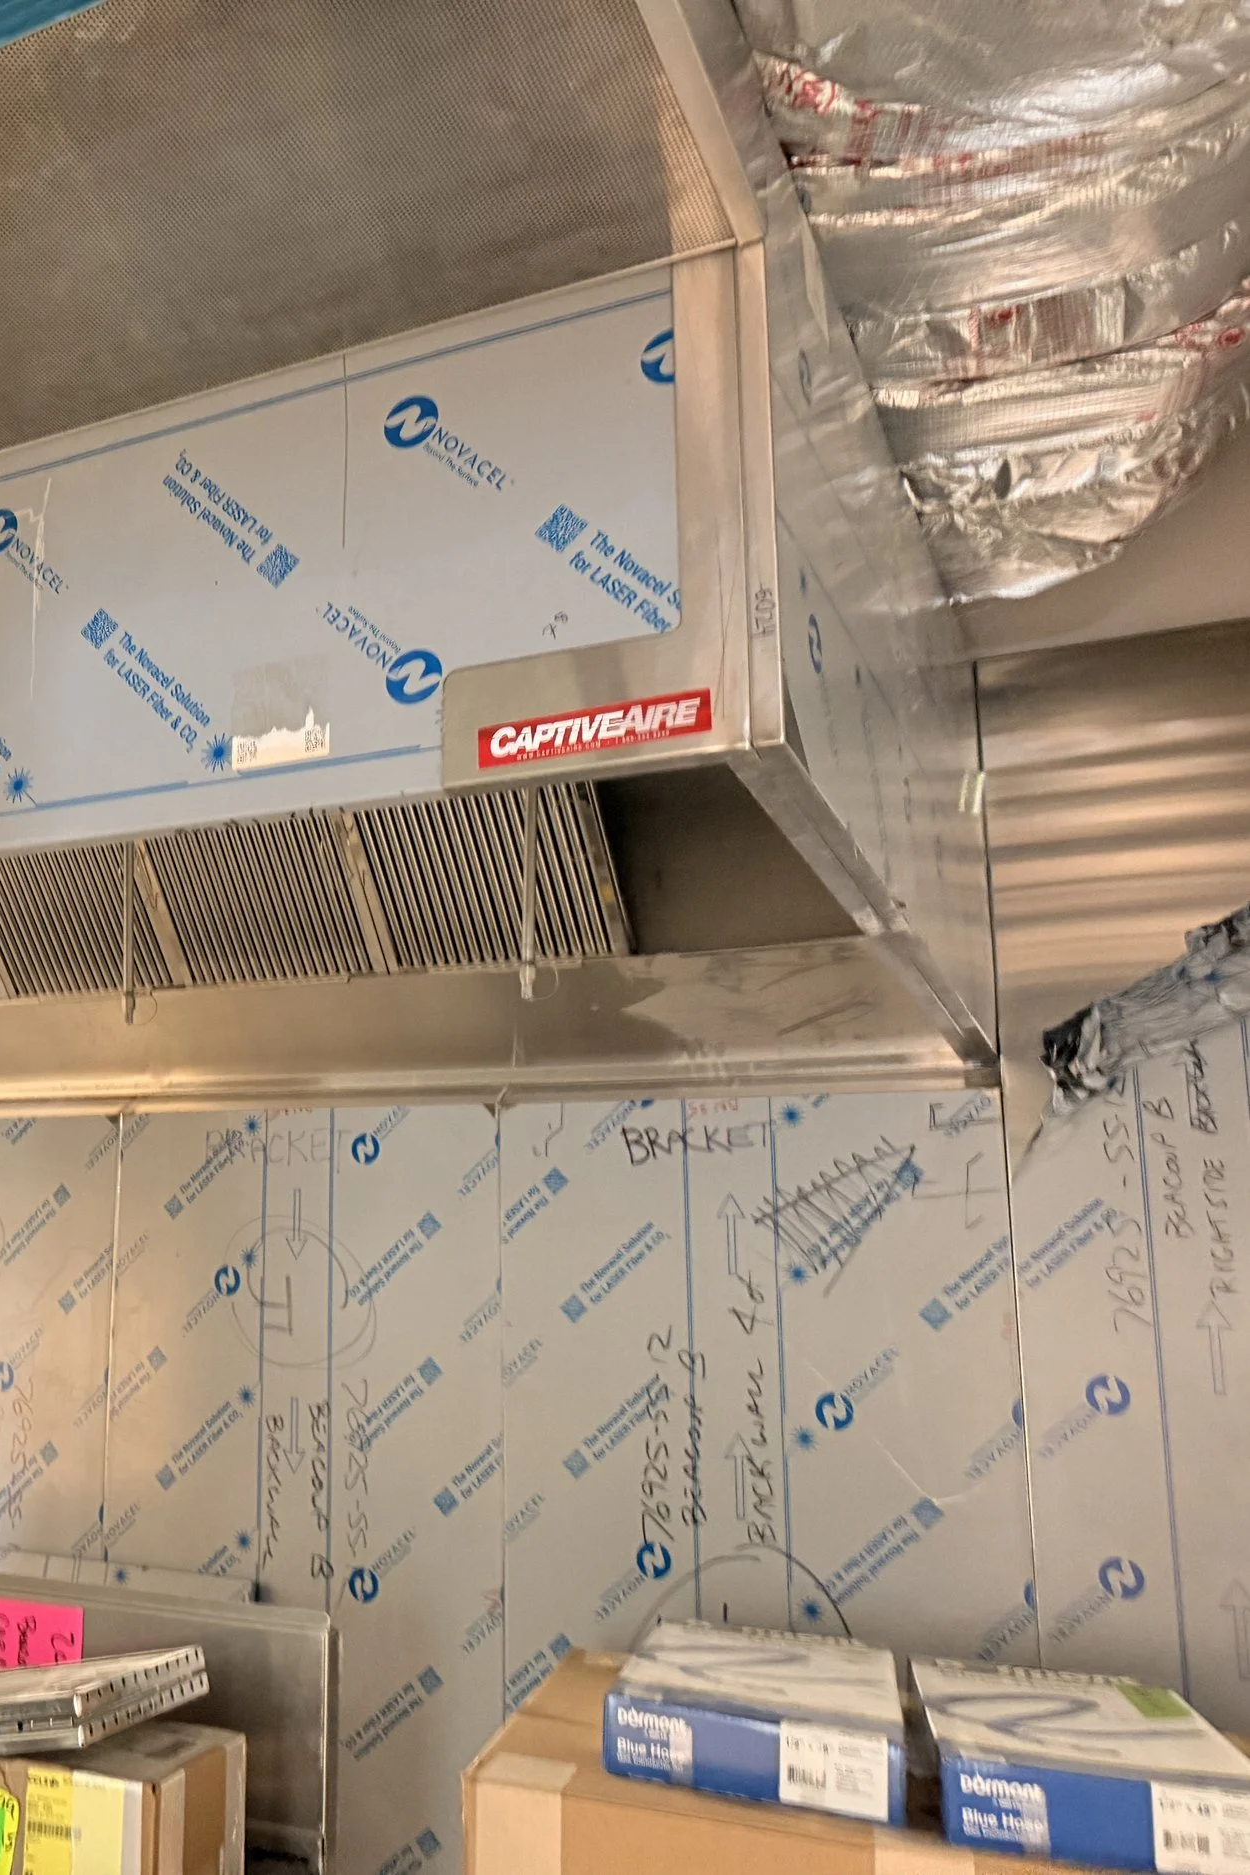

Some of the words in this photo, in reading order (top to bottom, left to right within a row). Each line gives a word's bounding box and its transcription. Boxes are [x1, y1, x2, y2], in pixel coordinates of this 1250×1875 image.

[431, 426, 505, 489] NOVACEL
[162, 474, 201, 513] Solution
[198, 476, 225, 505] Fiber
[196, 507, 238, 547] Novacel
[221, 496, 257, 531] LASER
[235, 539, 255, 564] The
[254, 524, 272, 545] for
[589, 530, 615, 557] The
[614, 549, 671, 596] Novacel
[569, 550, 592, 573] for
[589, 566, 637, 607] LASER
[633, 598, 671, 636] Fiber
[322, 602, 397, 668] NOVACEL
[103, 647, 120, 668] for
[116, 661, 150, 697] LASER
[146, 691, 172, 721] Fiber
[118, 630, 137, 655] The
[134, 648, 174, 689] Novacel
[170, 683, 210, 726] Solution
[490, 697, 701, 759] CAPTIVEAIRE
[621, 1121, 770, 1166] BRACKET
[616, 1705, 689, 1733] Dormont
[616, 1736, 646, 1757] Blue
[959, 1771, 1046, 1802] Dormont
[962, 1807, 999, 1829] Blue
